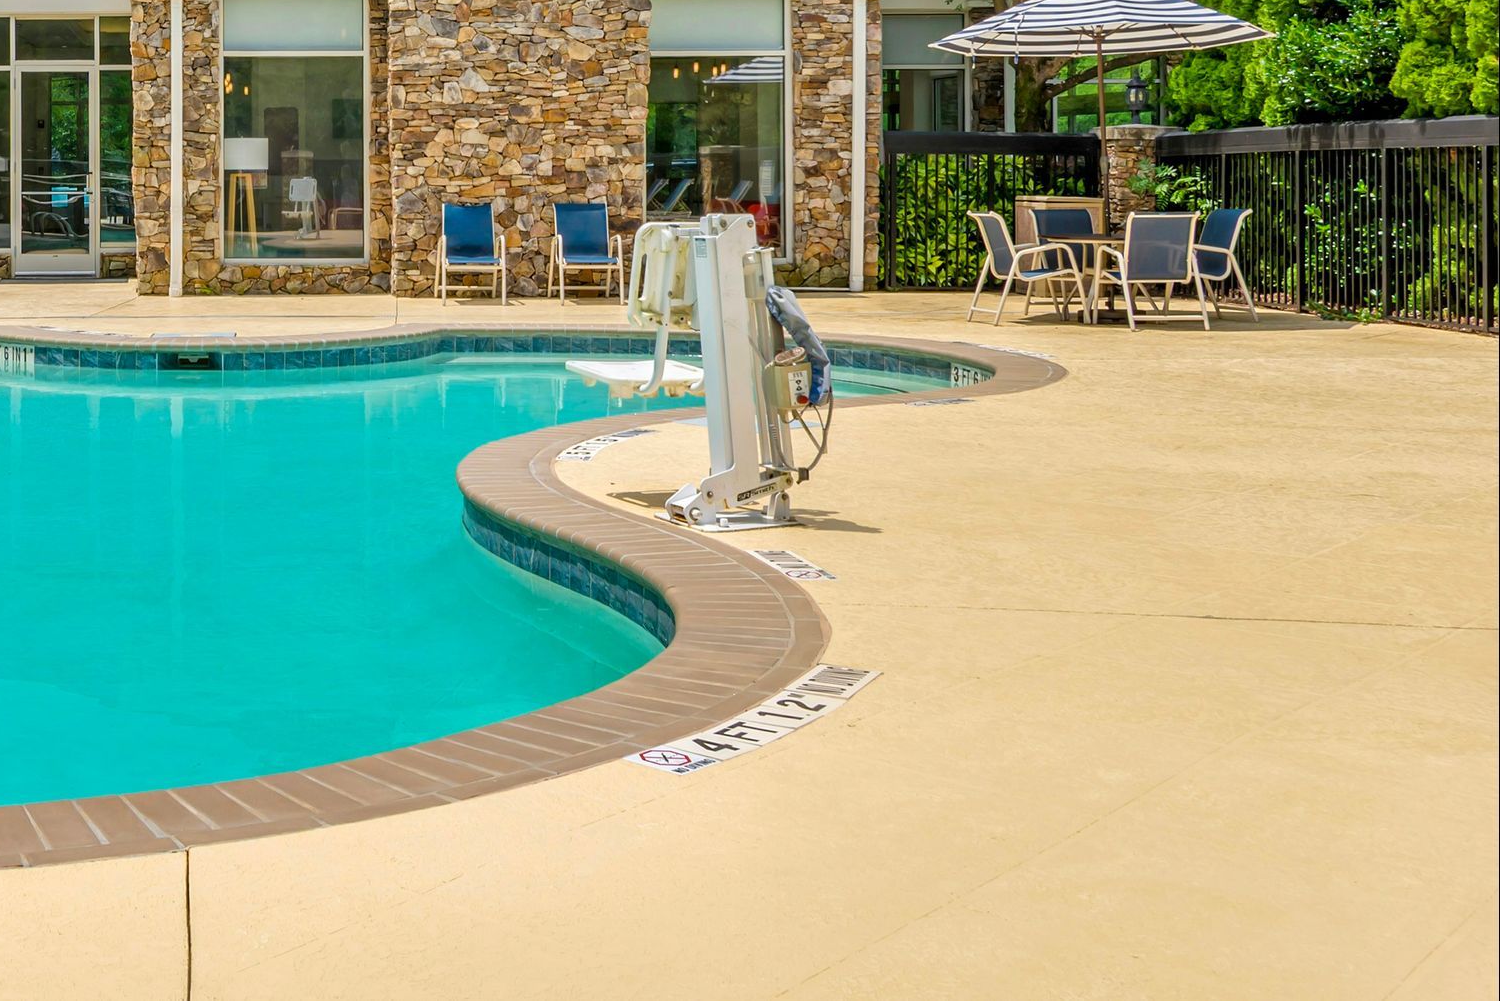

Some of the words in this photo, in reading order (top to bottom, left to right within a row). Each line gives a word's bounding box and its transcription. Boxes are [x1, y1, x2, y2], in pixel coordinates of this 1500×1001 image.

[4, 346, 9, 361] 6
[953, 366, 959, 382] 3
[713, 721, 778, 742] FT
[692, 738, 740, 752] 4
